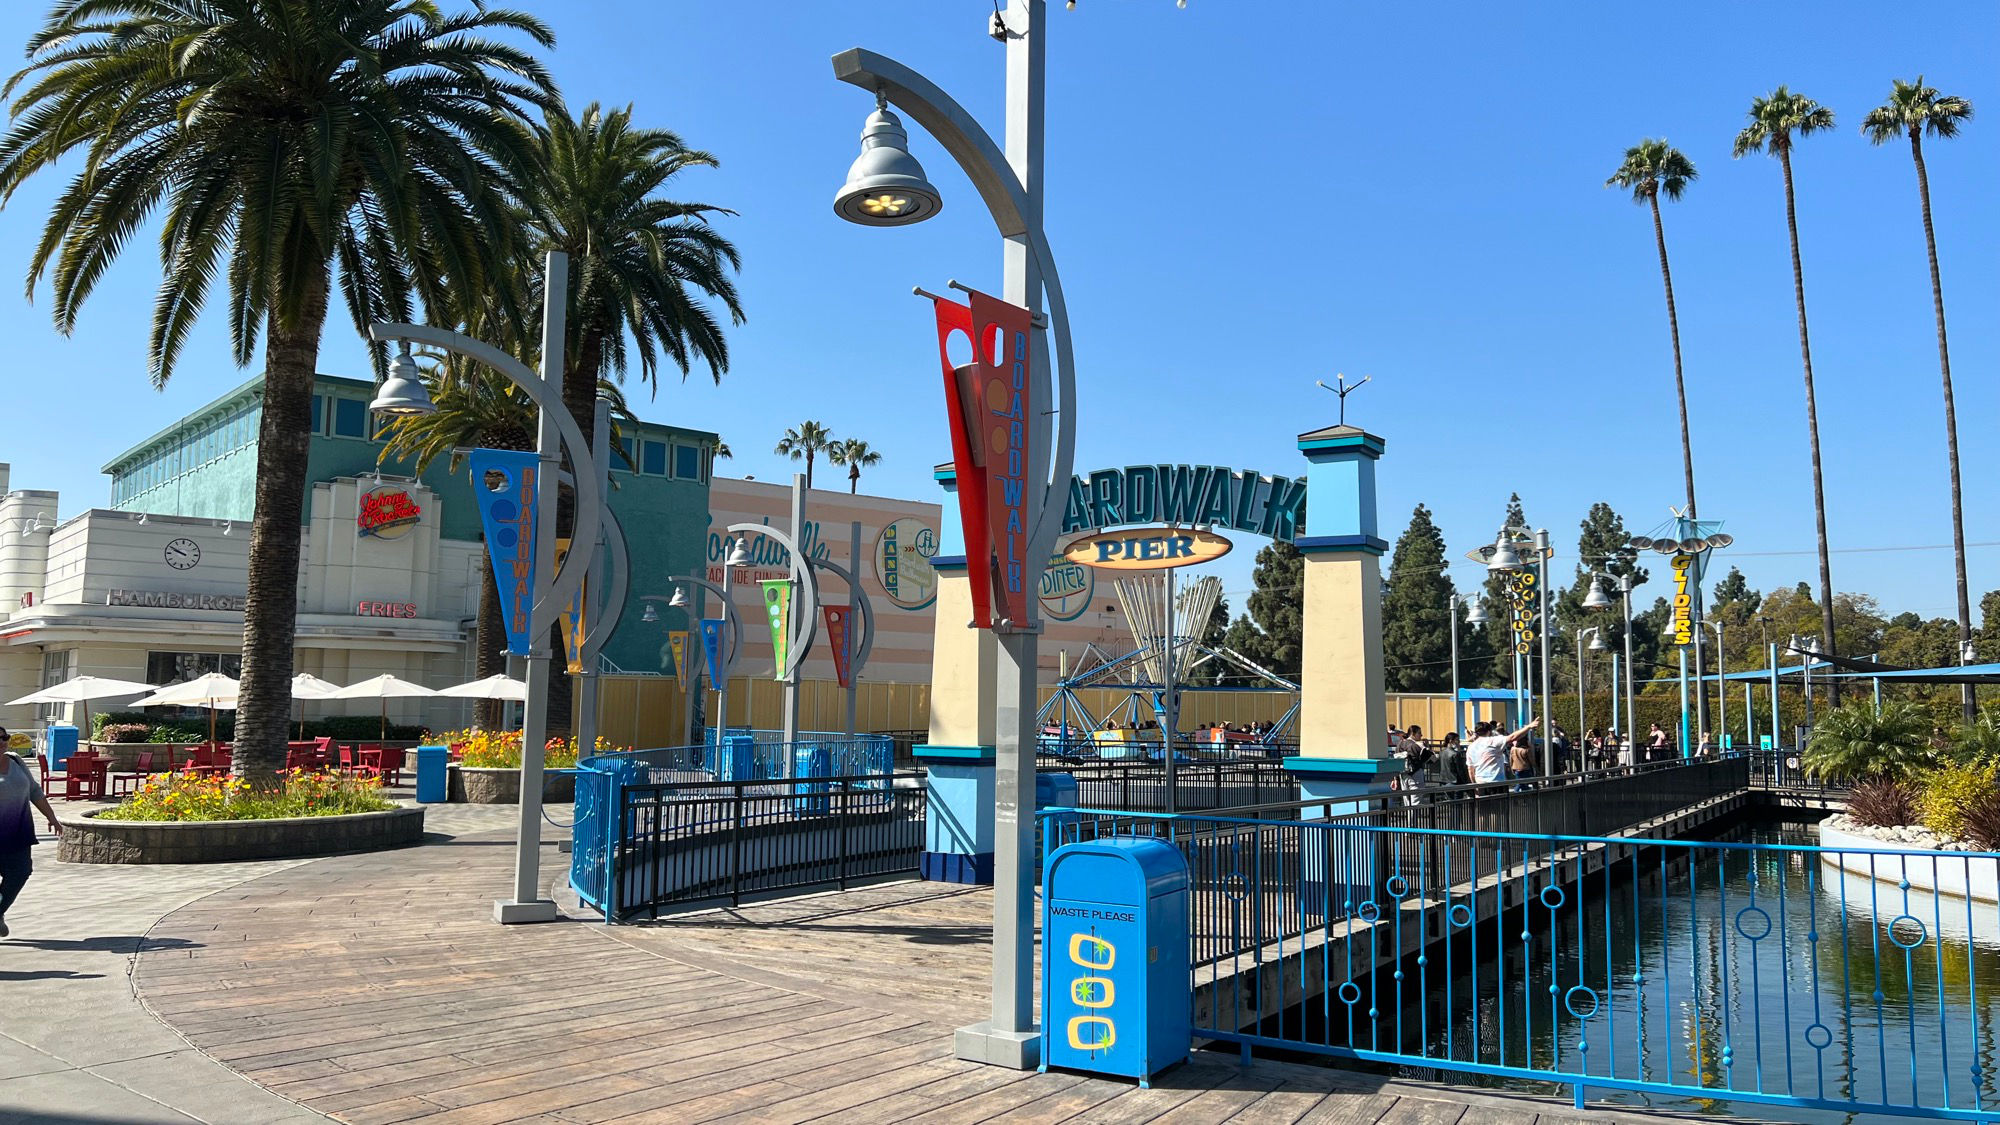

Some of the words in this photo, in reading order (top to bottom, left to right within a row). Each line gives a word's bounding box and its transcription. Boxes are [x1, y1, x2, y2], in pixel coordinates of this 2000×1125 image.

[1000, 331, 1025, 593] BOARDWALK
[358, 501, 420, 528] Rockets
[360, 492, 412, 512] Johnny
[508, 467, 535, 633] BOARDWALK
[1095, 535, 1195, 563] PIER
[1041, 567, 1085, 594] DINER
[359, 601, 417, 618] FRIES
[1671, 555, 1692, 645] GLIDERS
[1050, 906, 1089, 918] WASTE
[1091, 910, 1136, 922] PLEASE
